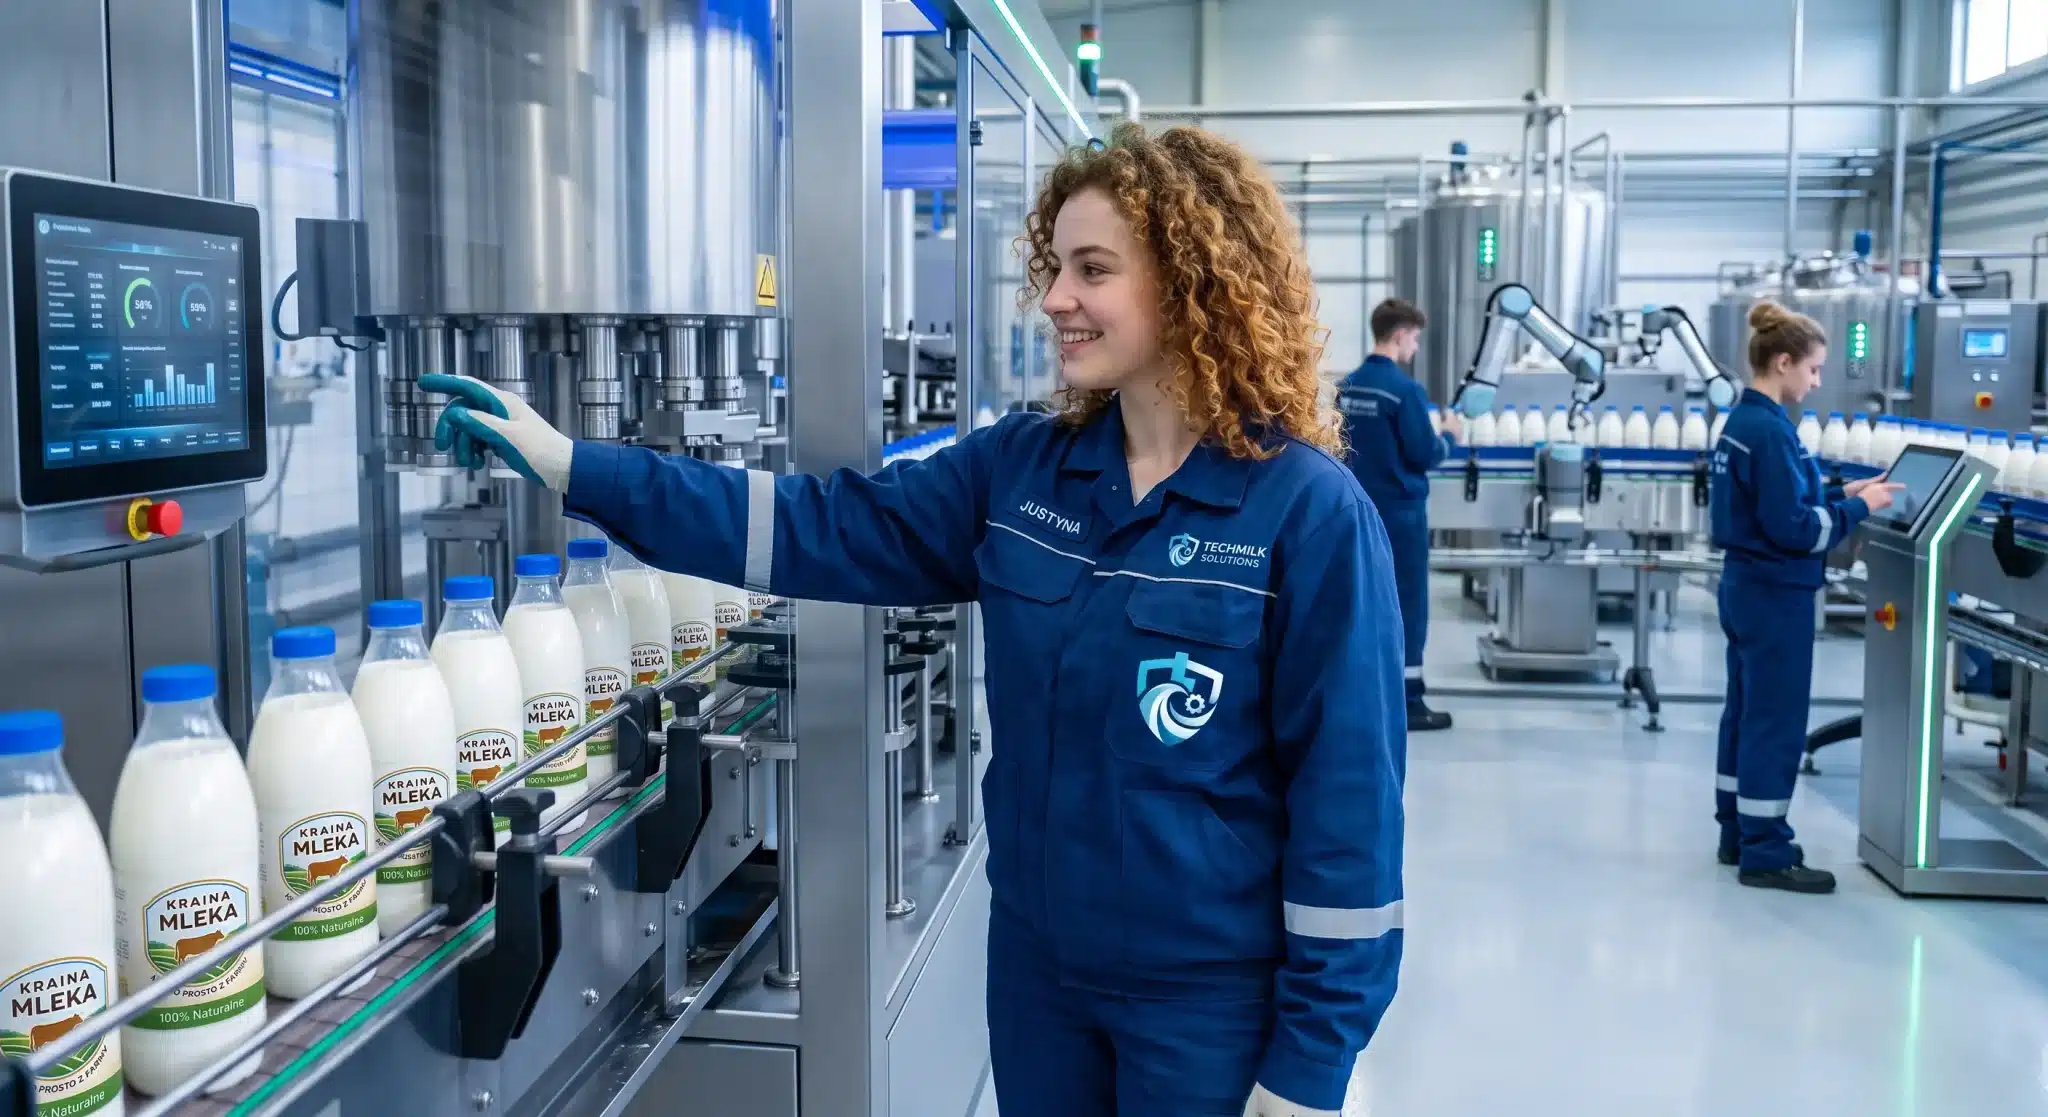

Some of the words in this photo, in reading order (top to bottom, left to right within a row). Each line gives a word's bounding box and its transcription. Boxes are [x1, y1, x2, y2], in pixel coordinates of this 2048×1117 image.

[1020, 500, 1081, 534] JUSTYNA
[1204, 542, 1268, 558] TECHMILK
[1200, 554, 1260, 568] SOLUTIONS
[674, 633, 708, 644] MLEKA
[632, 648, 660, 656] KRAINA
[631, 656, 664, 668] MLEKA
[585, 674, 618, 682] KRAINA
[585, 682, 622, 694] MLEKA
[533, 700, 571, 710] KRAINA
[528, 708, 575, 724] MLEKA
[464, 738, 506, 748] KRAINA
[460, 746, 512, 763] MLEKA
[388, 776, 436, 790] KRAINA
[382, 786, 442, 806] MLEKA
[300, 822, 354, 838] KRAINA
[294, 832, 360, 856] MLEKA
[382, 870, 404, 880] 100%
[166, 890, 230, 910] KRAINA
[159, 903, 238, 932] MLEKA
[293, 926, 318, 936] 100%
[321, 916, 364, 934] Naturalne
[20, 970, 90, 994] KRAINA
[182, 986, 218, 998] PROSTO
[218, 982, 226, 990] Z
[12, 984, 97, 1018] MLEKA
[160, 1012, 190, 1023] 100%
[193, 998, 245, 1020] Naturalne
[38, 1080, 76, 1094] PROSTO
[78, 1075, 84, 1084] Z
[51, 1091, 105, 1117] Naturalne
